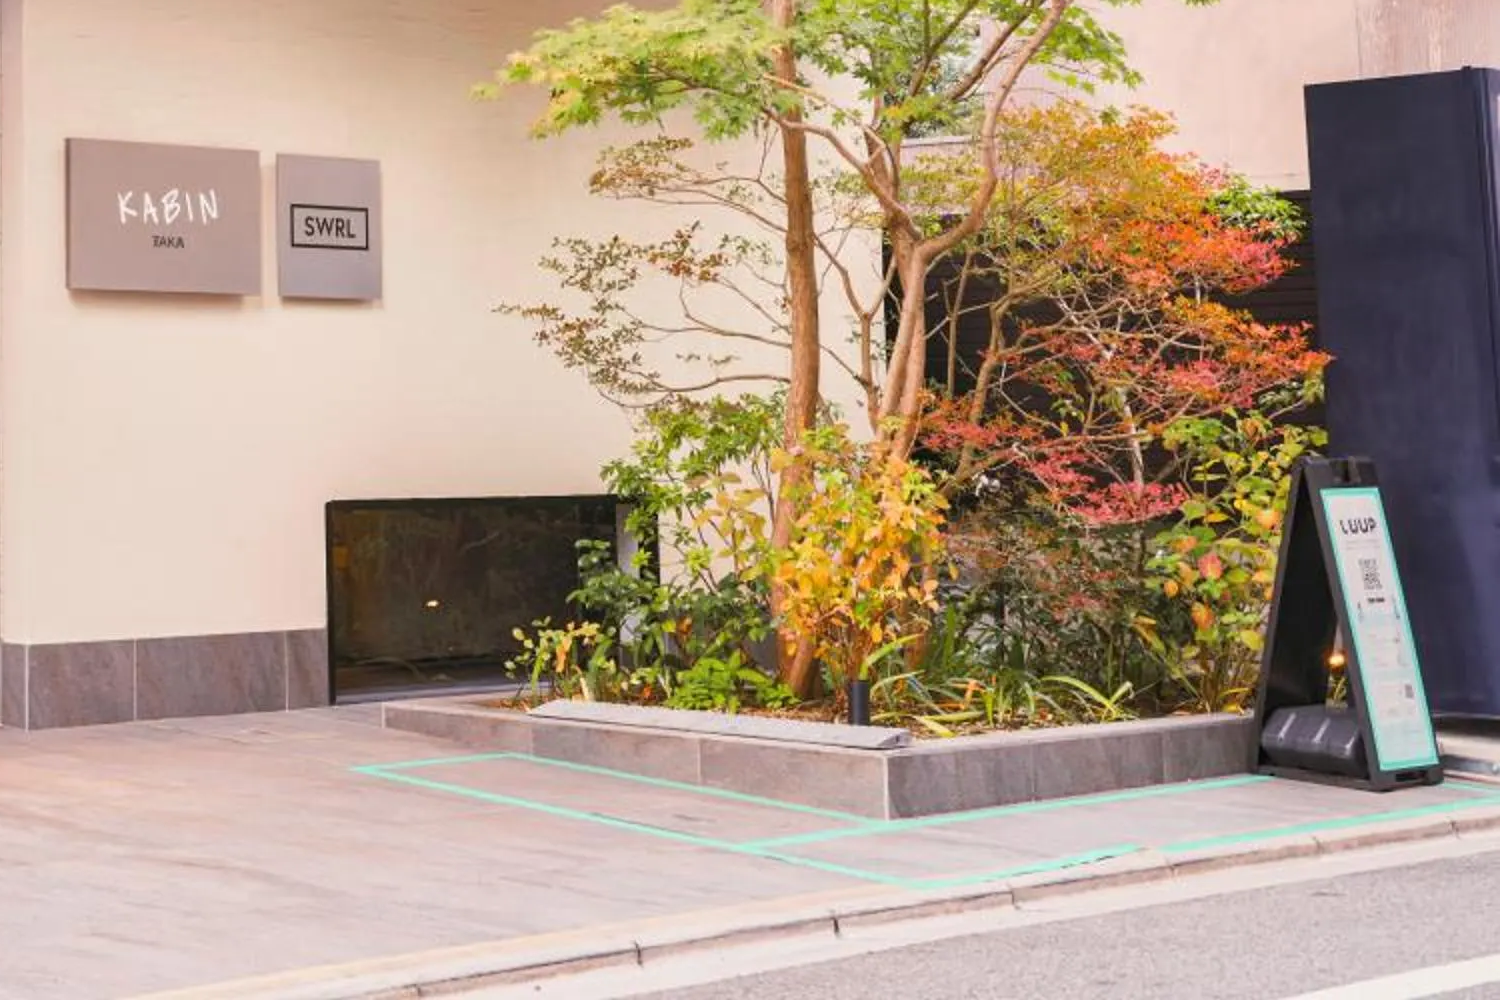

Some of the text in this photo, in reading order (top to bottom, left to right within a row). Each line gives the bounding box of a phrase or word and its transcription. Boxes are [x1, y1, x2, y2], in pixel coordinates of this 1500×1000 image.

[117, 188, 220, 225] KABIN
[304, 216, 356, 239] SWRL
[152, 235, 184, 248] TAKA
[1340, 517, 1377, 534] LUUP
